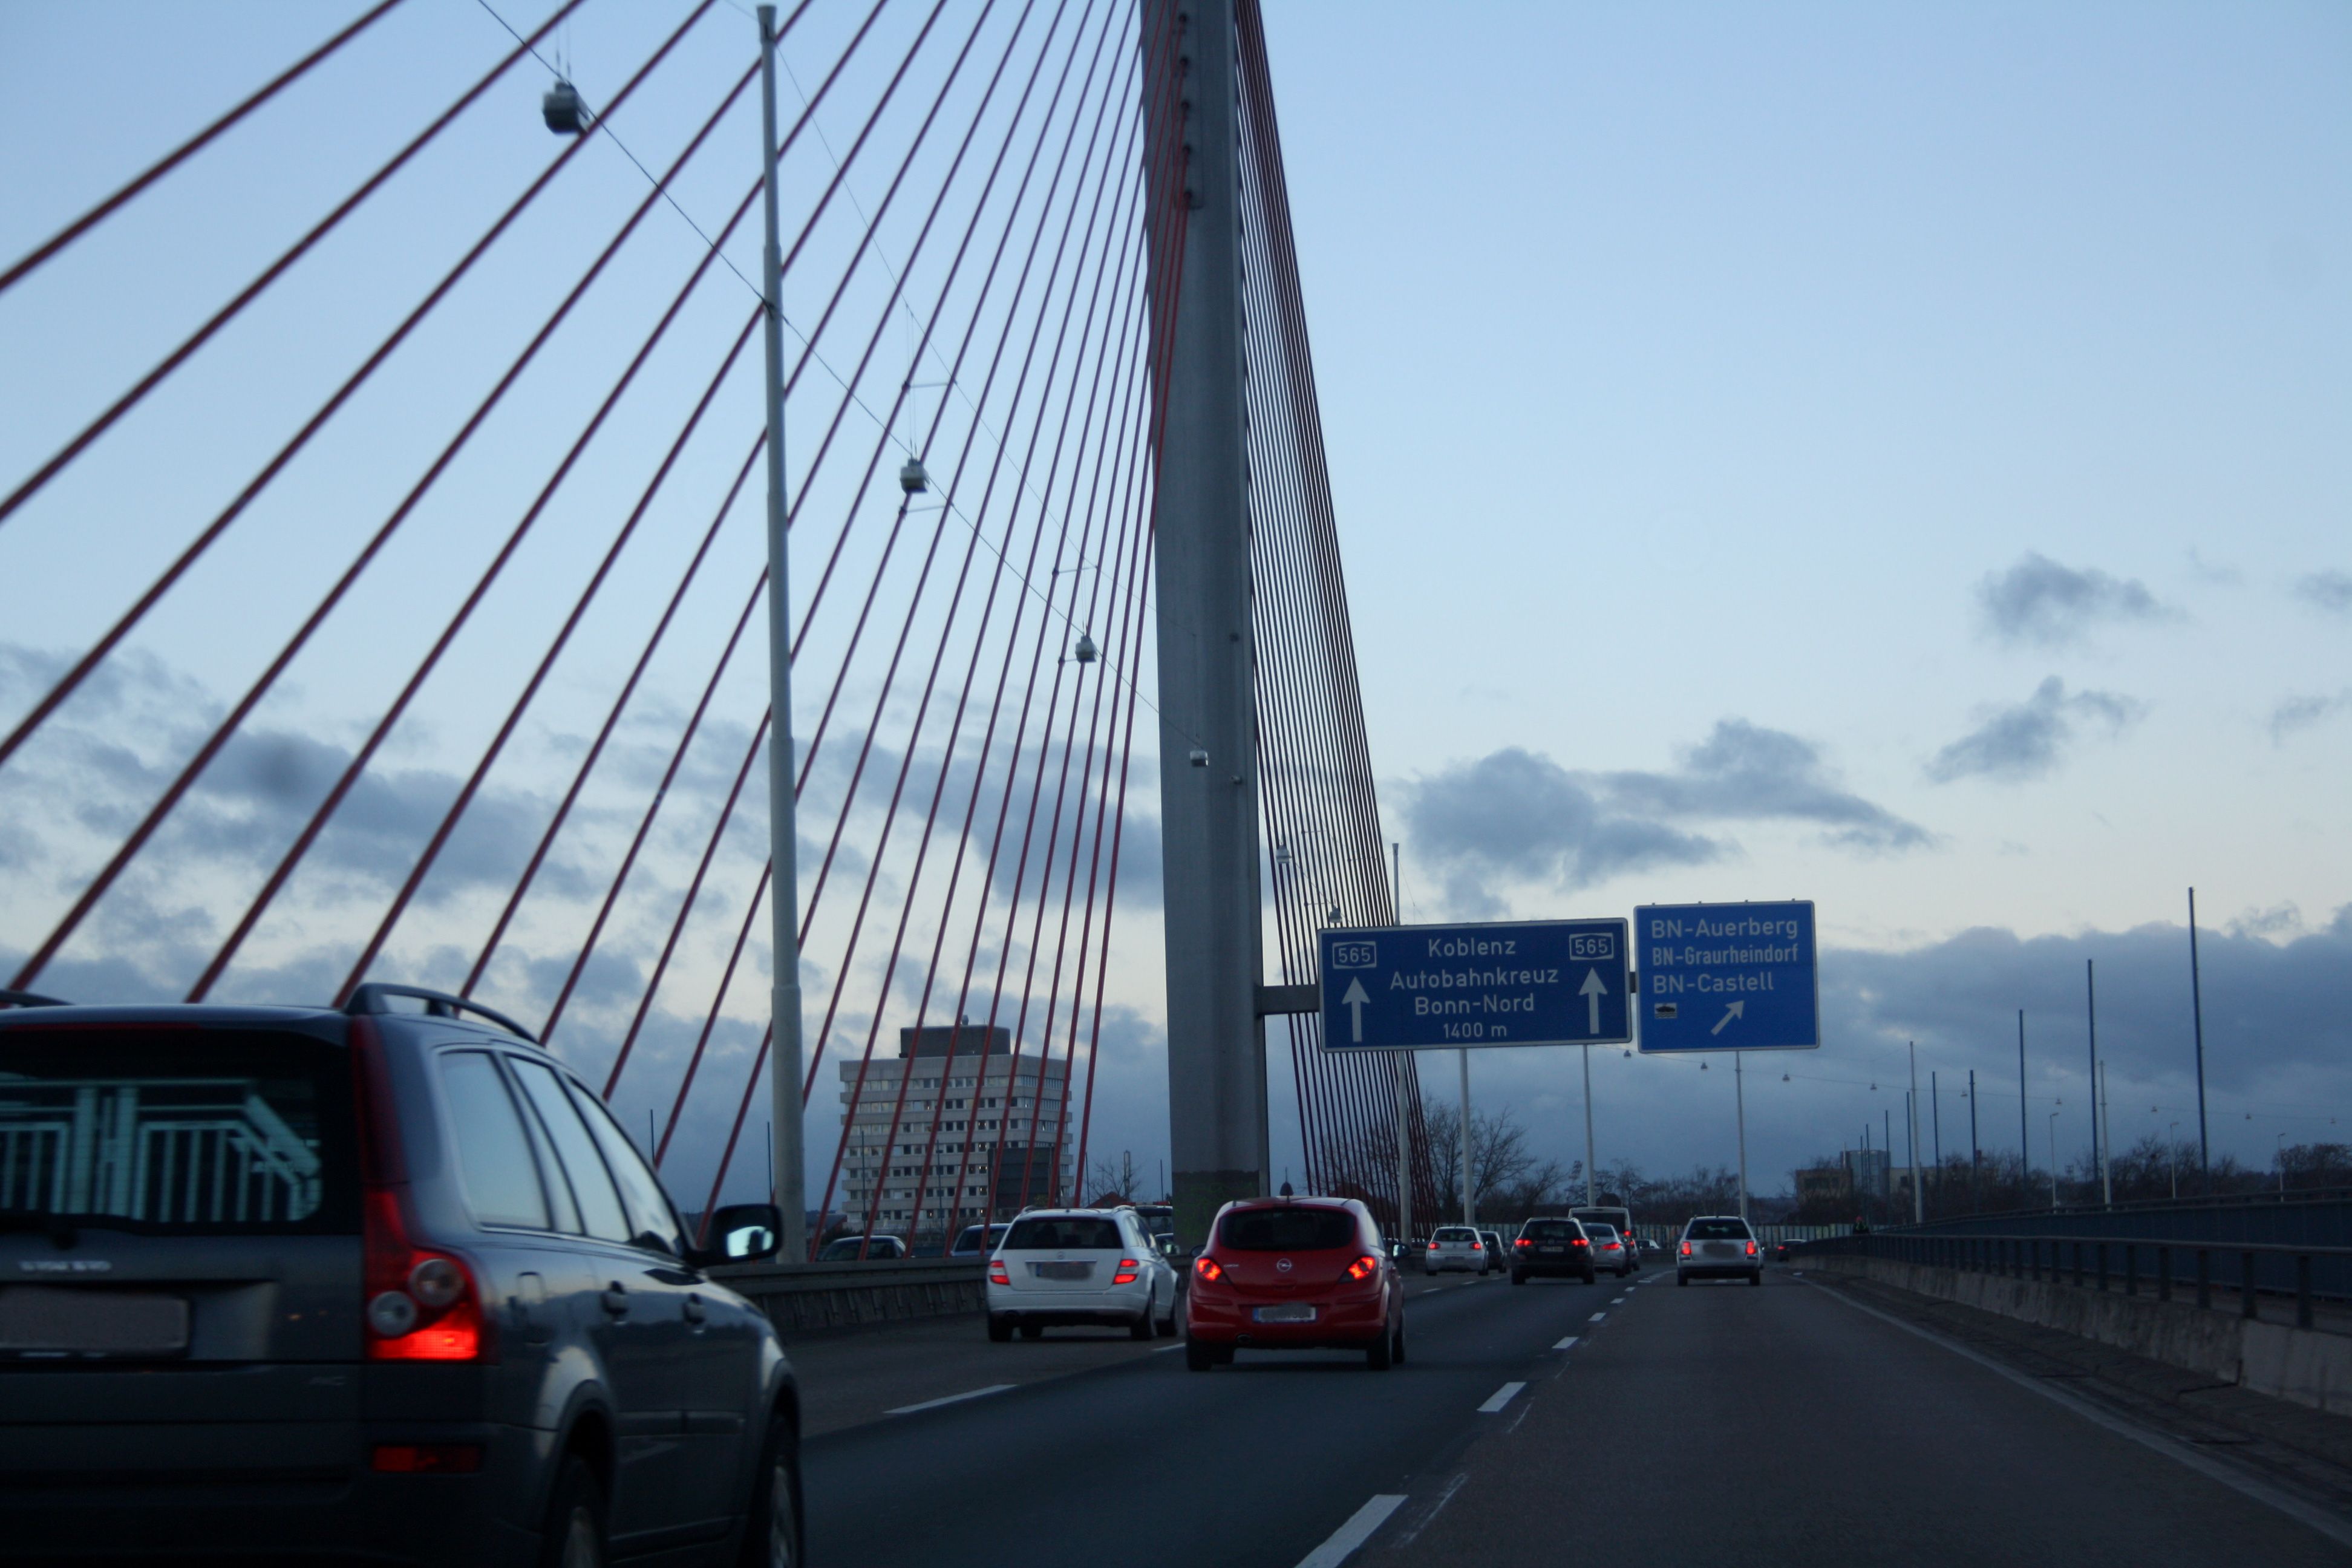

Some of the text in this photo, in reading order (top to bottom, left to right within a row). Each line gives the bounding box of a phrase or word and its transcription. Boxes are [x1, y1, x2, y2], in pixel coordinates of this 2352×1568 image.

[1651, 917, 1798, 939] BN-Auerberg
[1338, 947, 1371, 963] 565
[1428, 938, 1516, 957] Koblenz
[1575, 938, 1608, 955] 565
[1652, 943, 1798, 966] BN-Graurheindorf
[1390, 966, 1559, 990] Autobahnkreuz
[1653, 972, 1774, 994] BN-Castell
[1414, 992, 1535, 1015] Bonn-Nord
[1443, 1022, 1507, 1039] 1400 m
